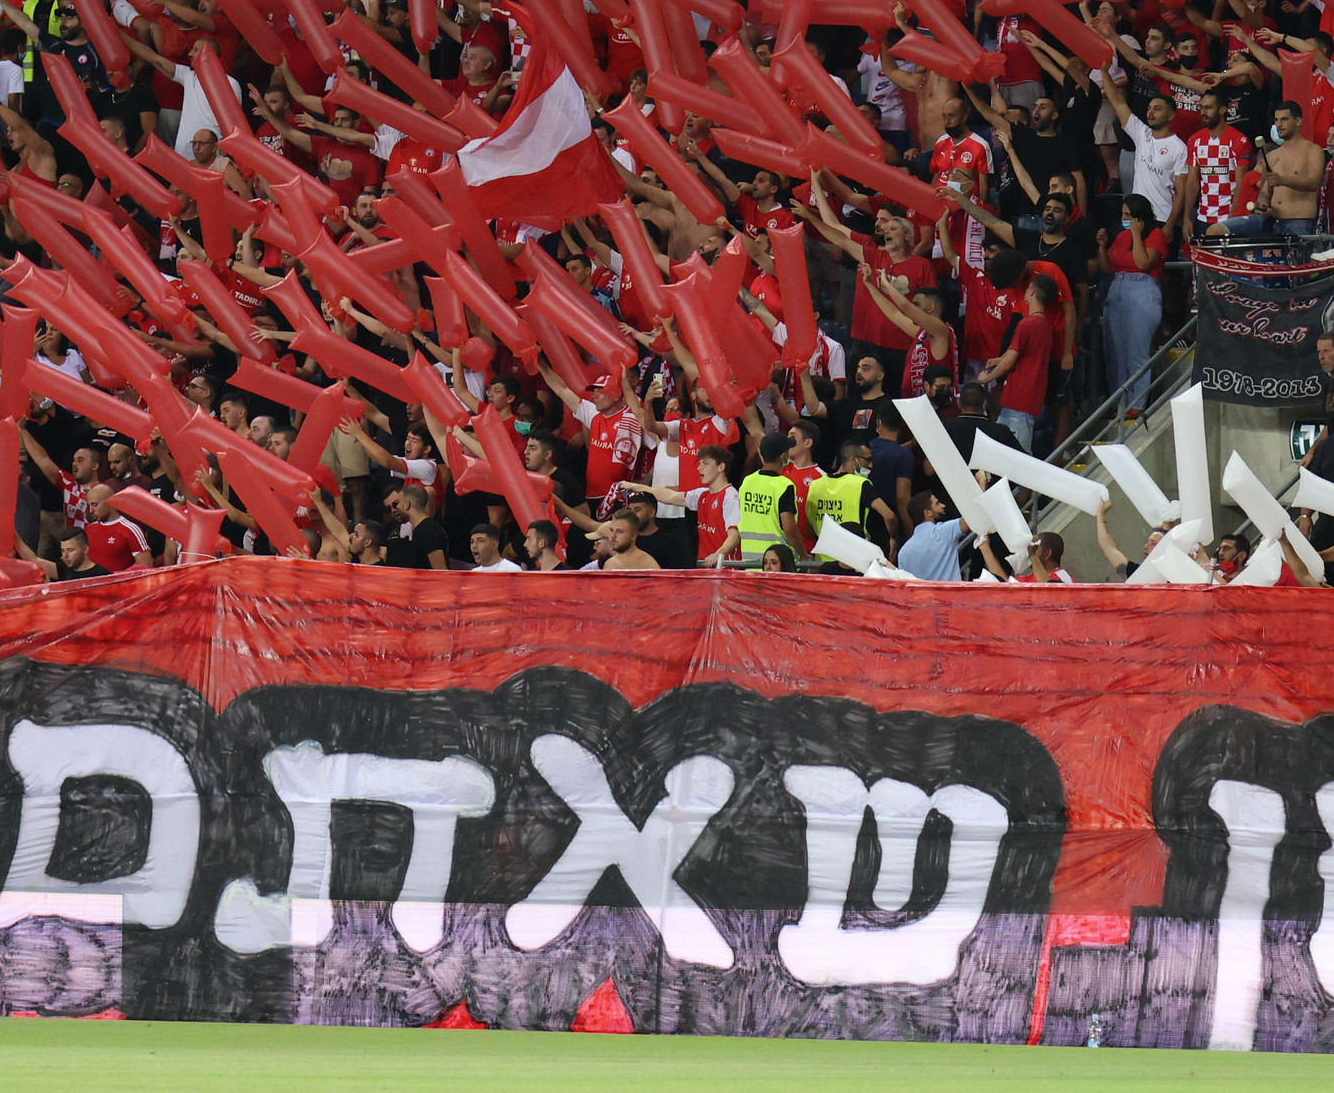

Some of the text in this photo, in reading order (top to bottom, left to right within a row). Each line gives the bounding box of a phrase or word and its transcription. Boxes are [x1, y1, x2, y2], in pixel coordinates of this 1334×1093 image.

[1202, 367, 1323, 398] 1978-2013
[744, 491, 773, 506] ניצנים
[817, 499, 843, 511] ניצנים
